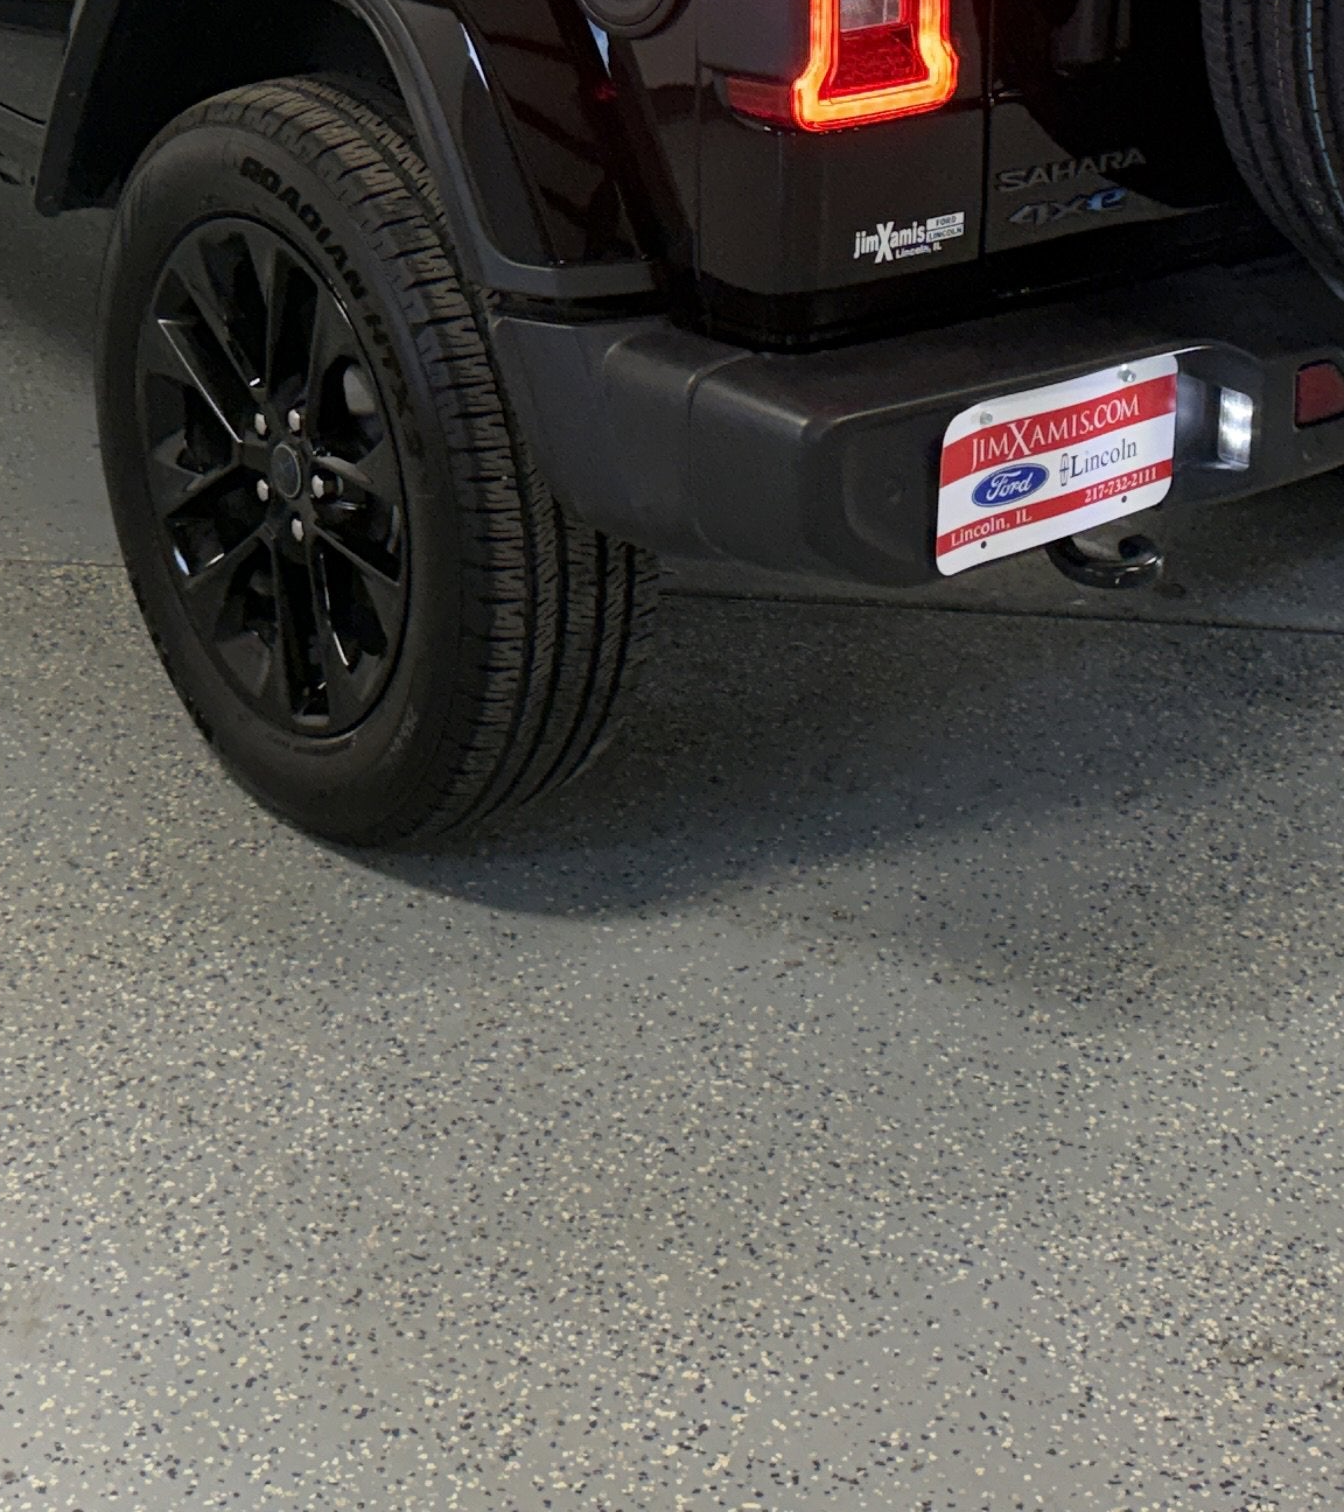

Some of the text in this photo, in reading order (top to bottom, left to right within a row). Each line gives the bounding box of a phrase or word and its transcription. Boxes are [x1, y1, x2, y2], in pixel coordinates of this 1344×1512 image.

[995, 146, 1147, 192] SAHARA
[240, 156, 367, 299] ROADIAN
[1070, 438, 1137, 478] Lincoln
[986, 469, 1033, 501] Ford
[1084, 469, 1157, 503] 217-732-2111
[1016, 508, 1032, 525] IL
